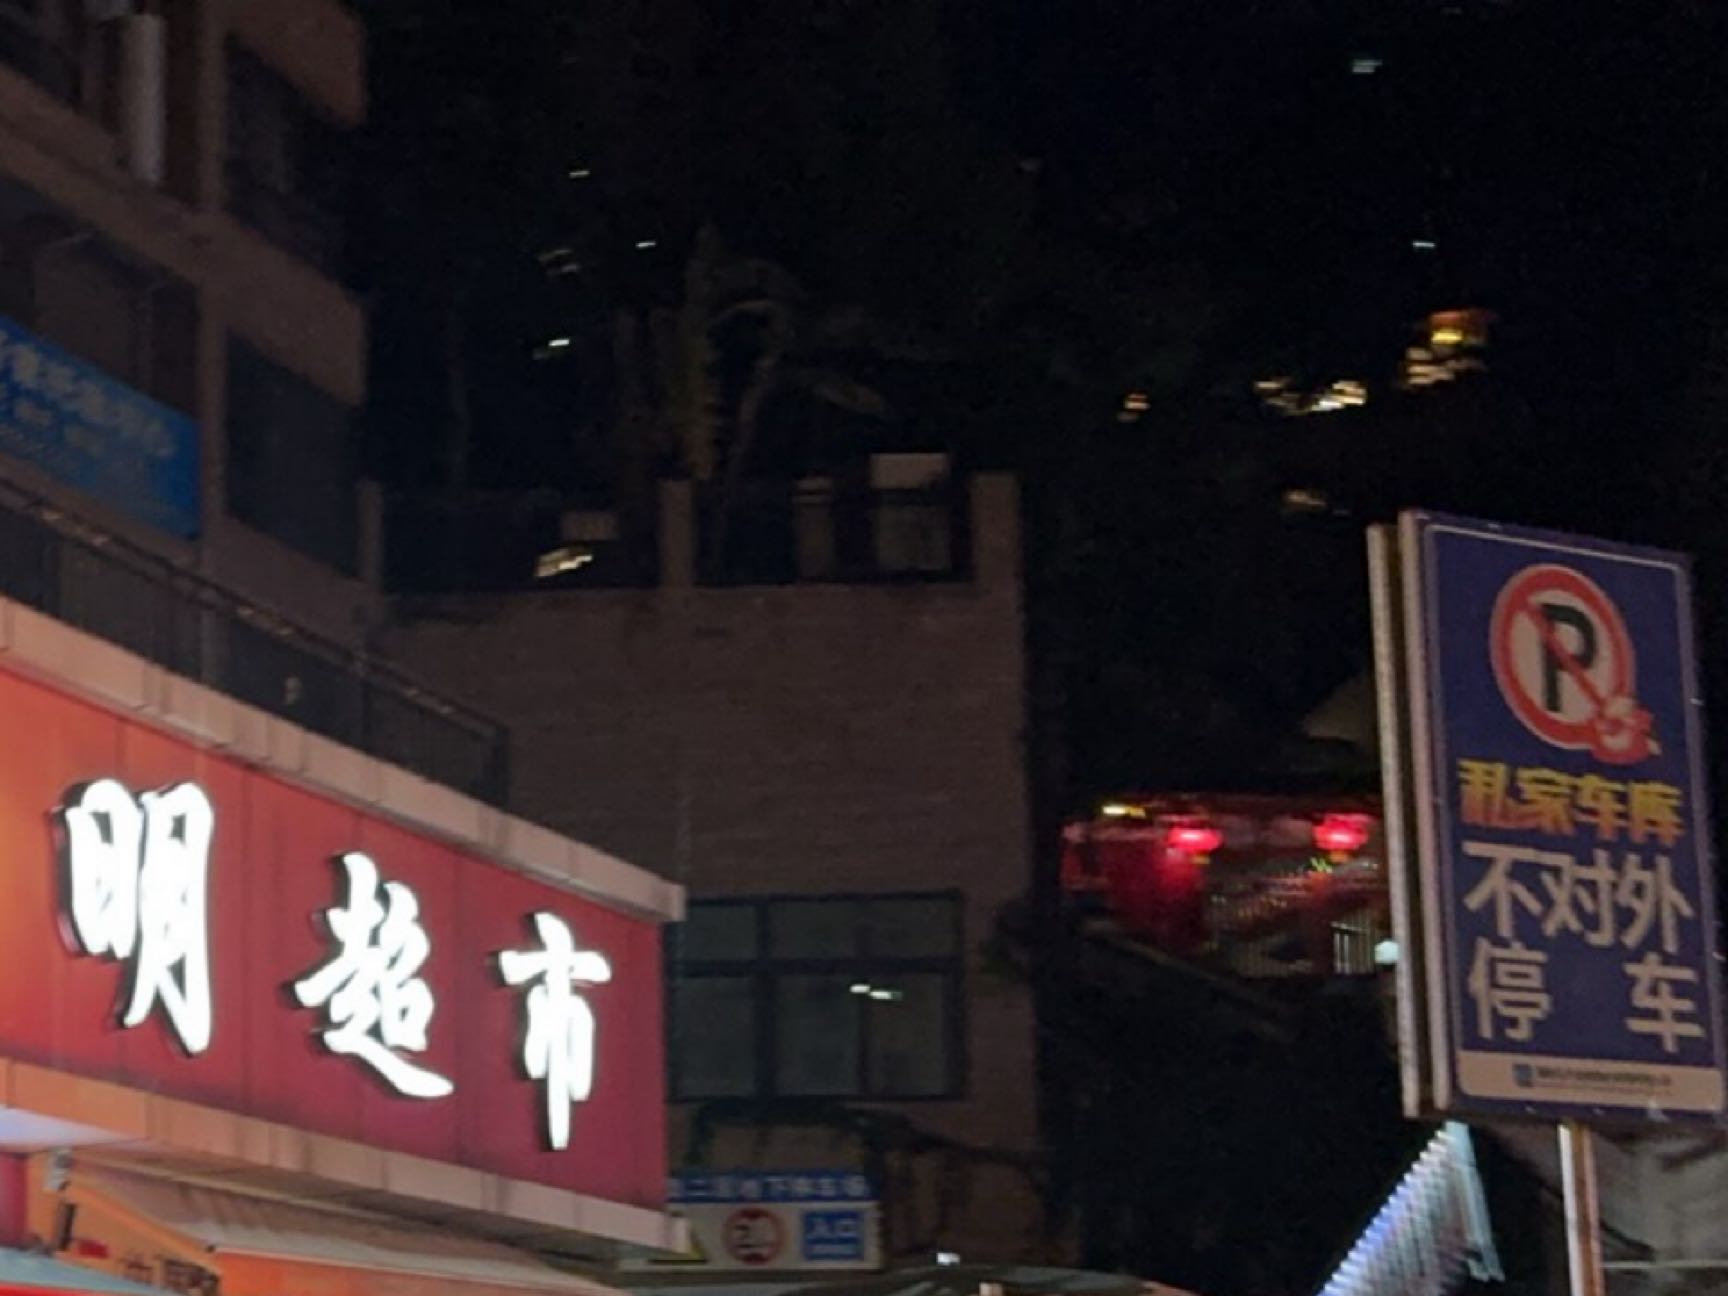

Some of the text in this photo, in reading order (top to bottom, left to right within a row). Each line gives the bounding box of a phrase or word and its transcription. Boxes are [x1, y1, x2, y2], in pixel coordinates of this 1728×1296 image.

[1456, 758, 1688, 846] 私家车库
[1462, 840, 1696, 954] 不对外
[1466, 934, 1706, 1054] 停车
